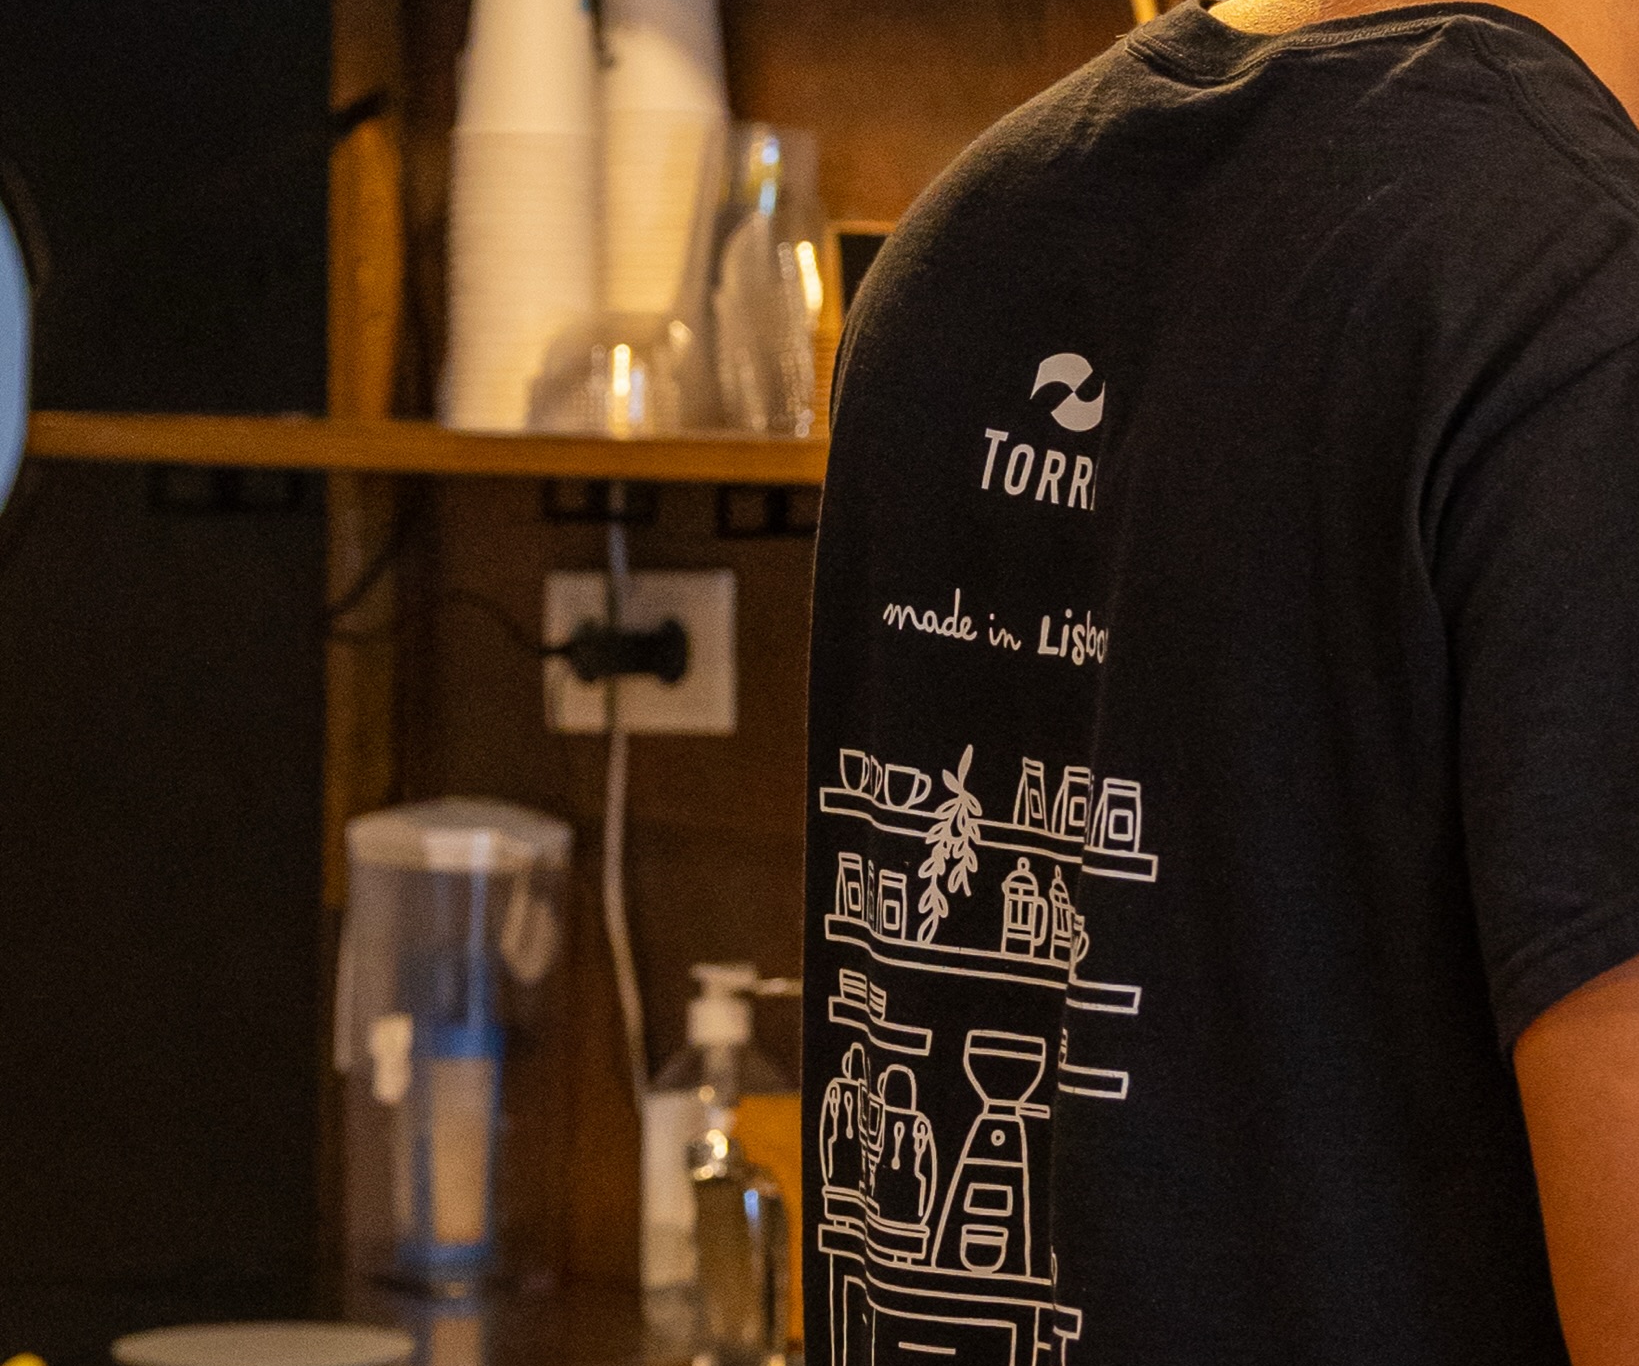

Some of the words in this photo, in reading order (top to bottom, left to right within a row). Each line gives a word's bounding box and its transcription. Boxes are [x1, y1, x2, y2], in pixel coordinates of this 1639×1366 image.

[981, 428, 1099, 511] TORR
[883, 588, 977, 641] made
[989, 613, 1021, 651] in
